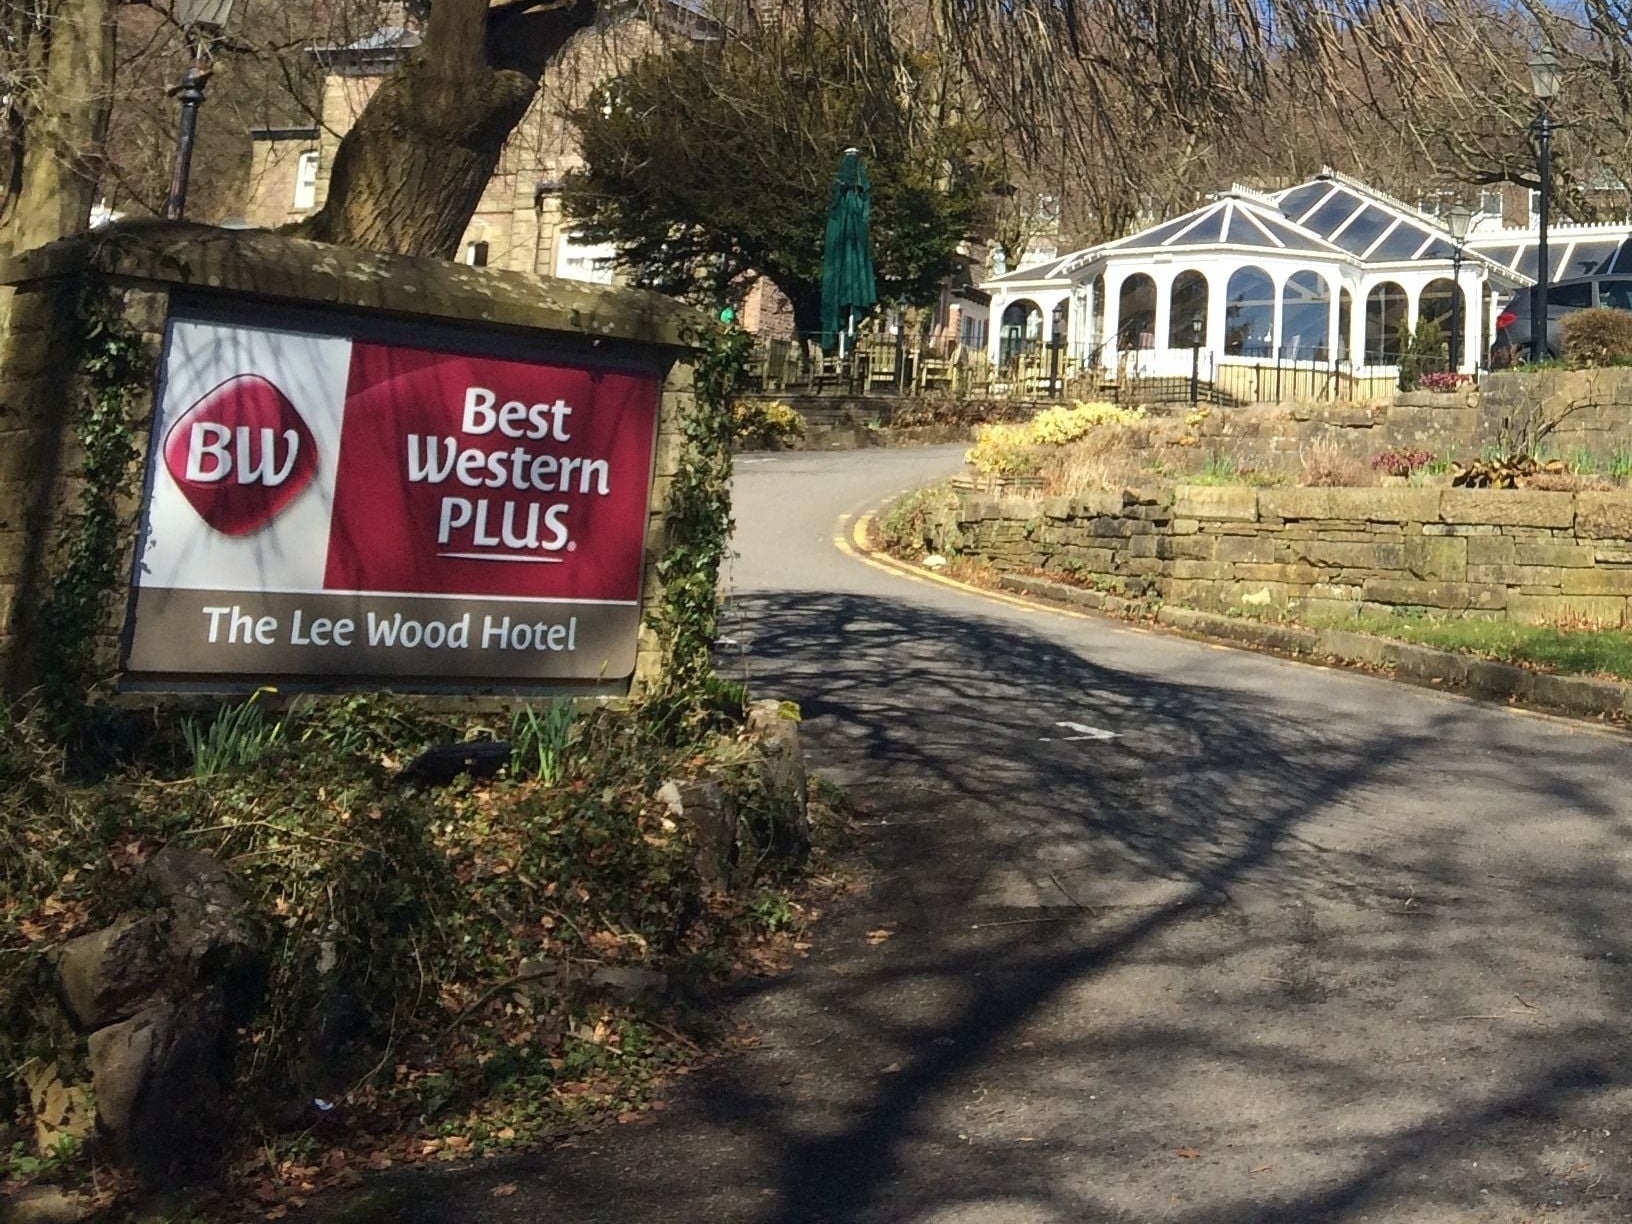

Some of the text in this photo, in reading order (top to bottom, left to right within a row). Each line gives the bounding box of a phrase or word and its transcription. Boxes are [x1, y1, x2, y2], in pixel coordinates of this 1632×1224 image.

[461, 387, 572, 441] Best
[184, 422, 299, 487] BW
[407, 434, 611, 496] Western
[437, 497, 569, 551] PLUS
[202, 606, 577, 652] The Lee Wood Hotel
